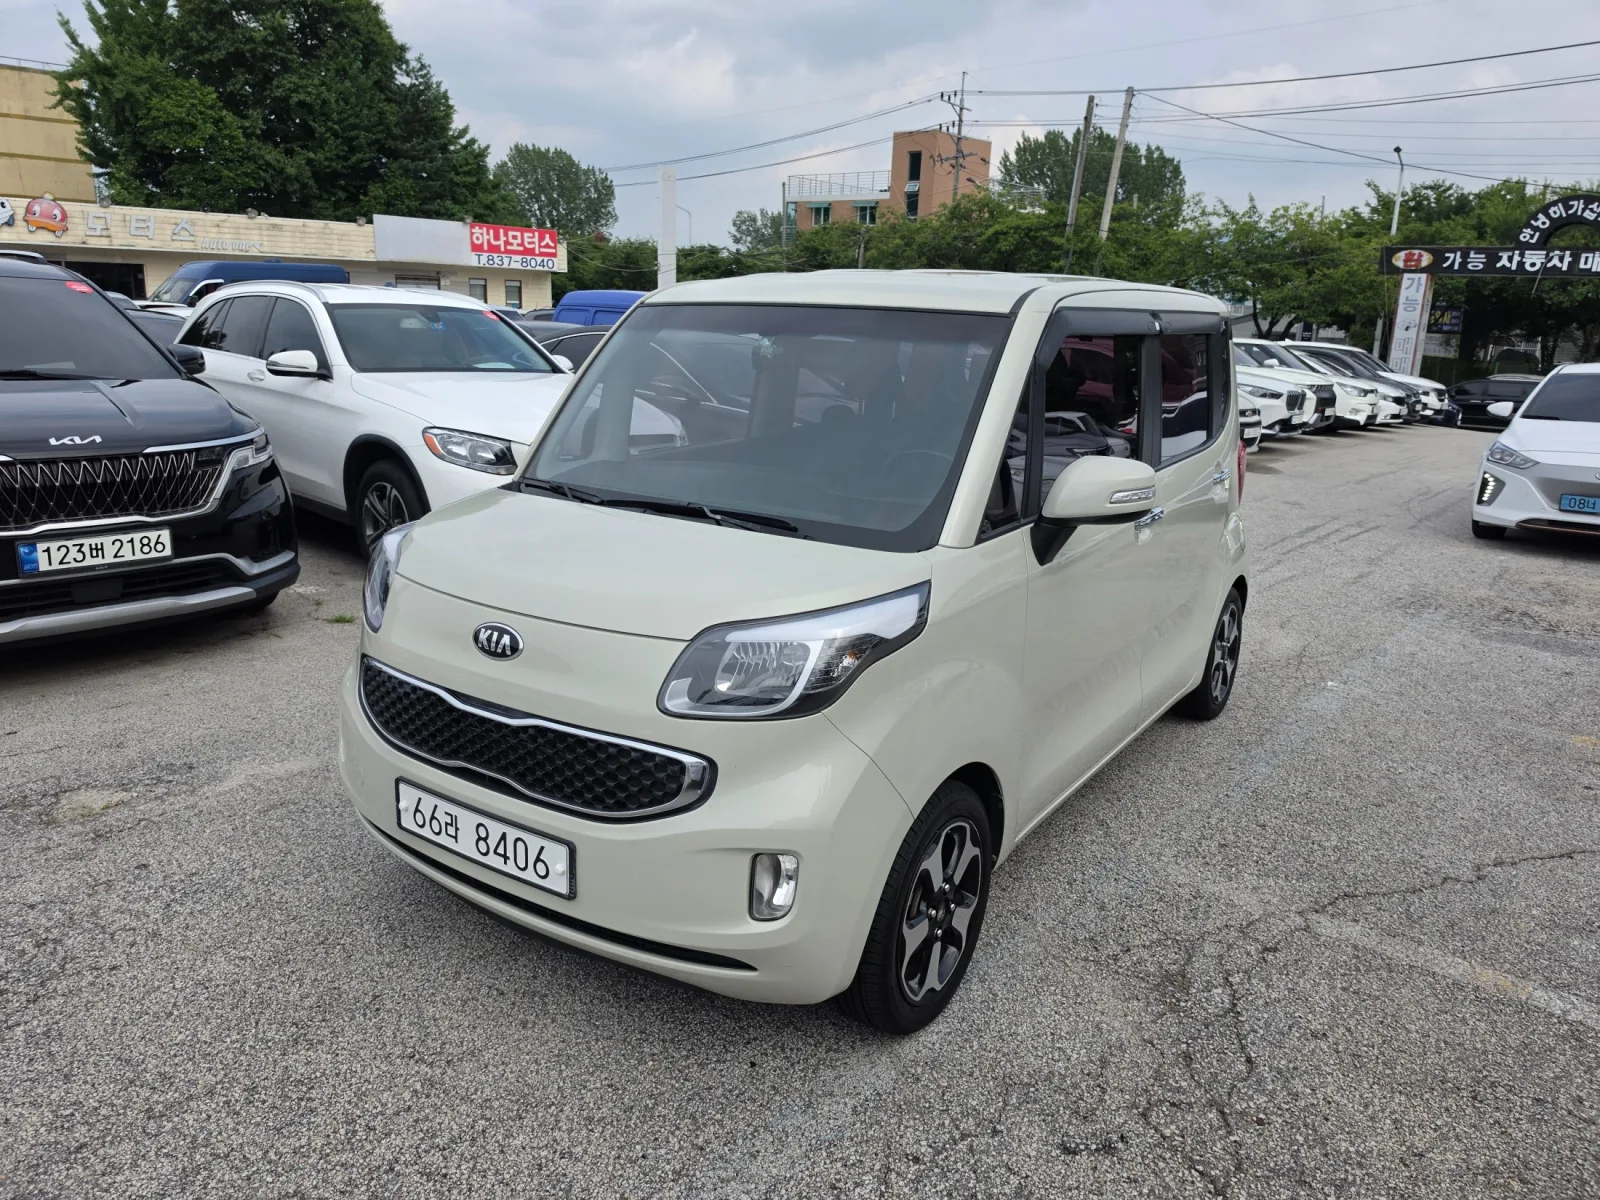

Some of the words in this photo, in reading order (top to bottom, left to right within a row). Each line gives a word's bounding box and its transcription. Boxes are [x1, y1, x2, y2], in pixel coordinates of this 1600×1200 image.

[84, 211, 195, 242] 모터스
[1519, 199, 1600, 243] 안녕히가십
[471, 226, 556, 254] 하나모터스
[474, 253, 555, 269] T.837-8040
[1442, 250, 1487, 270] 가능
[1496, 250, 1572, 272] 자동차
[1404, 276, 1423, 313] 가능
[48, 435, 102, 446] KIA
[1568, 497, 1596, 510] 08너
[41, 542, 105, 567] 123버
[111, 534, 166, 559] 2186
[477, 628, 512, 656] KIA
[413, 796, 460, 844] 66라
[475, 822, 550, 880] 8406
